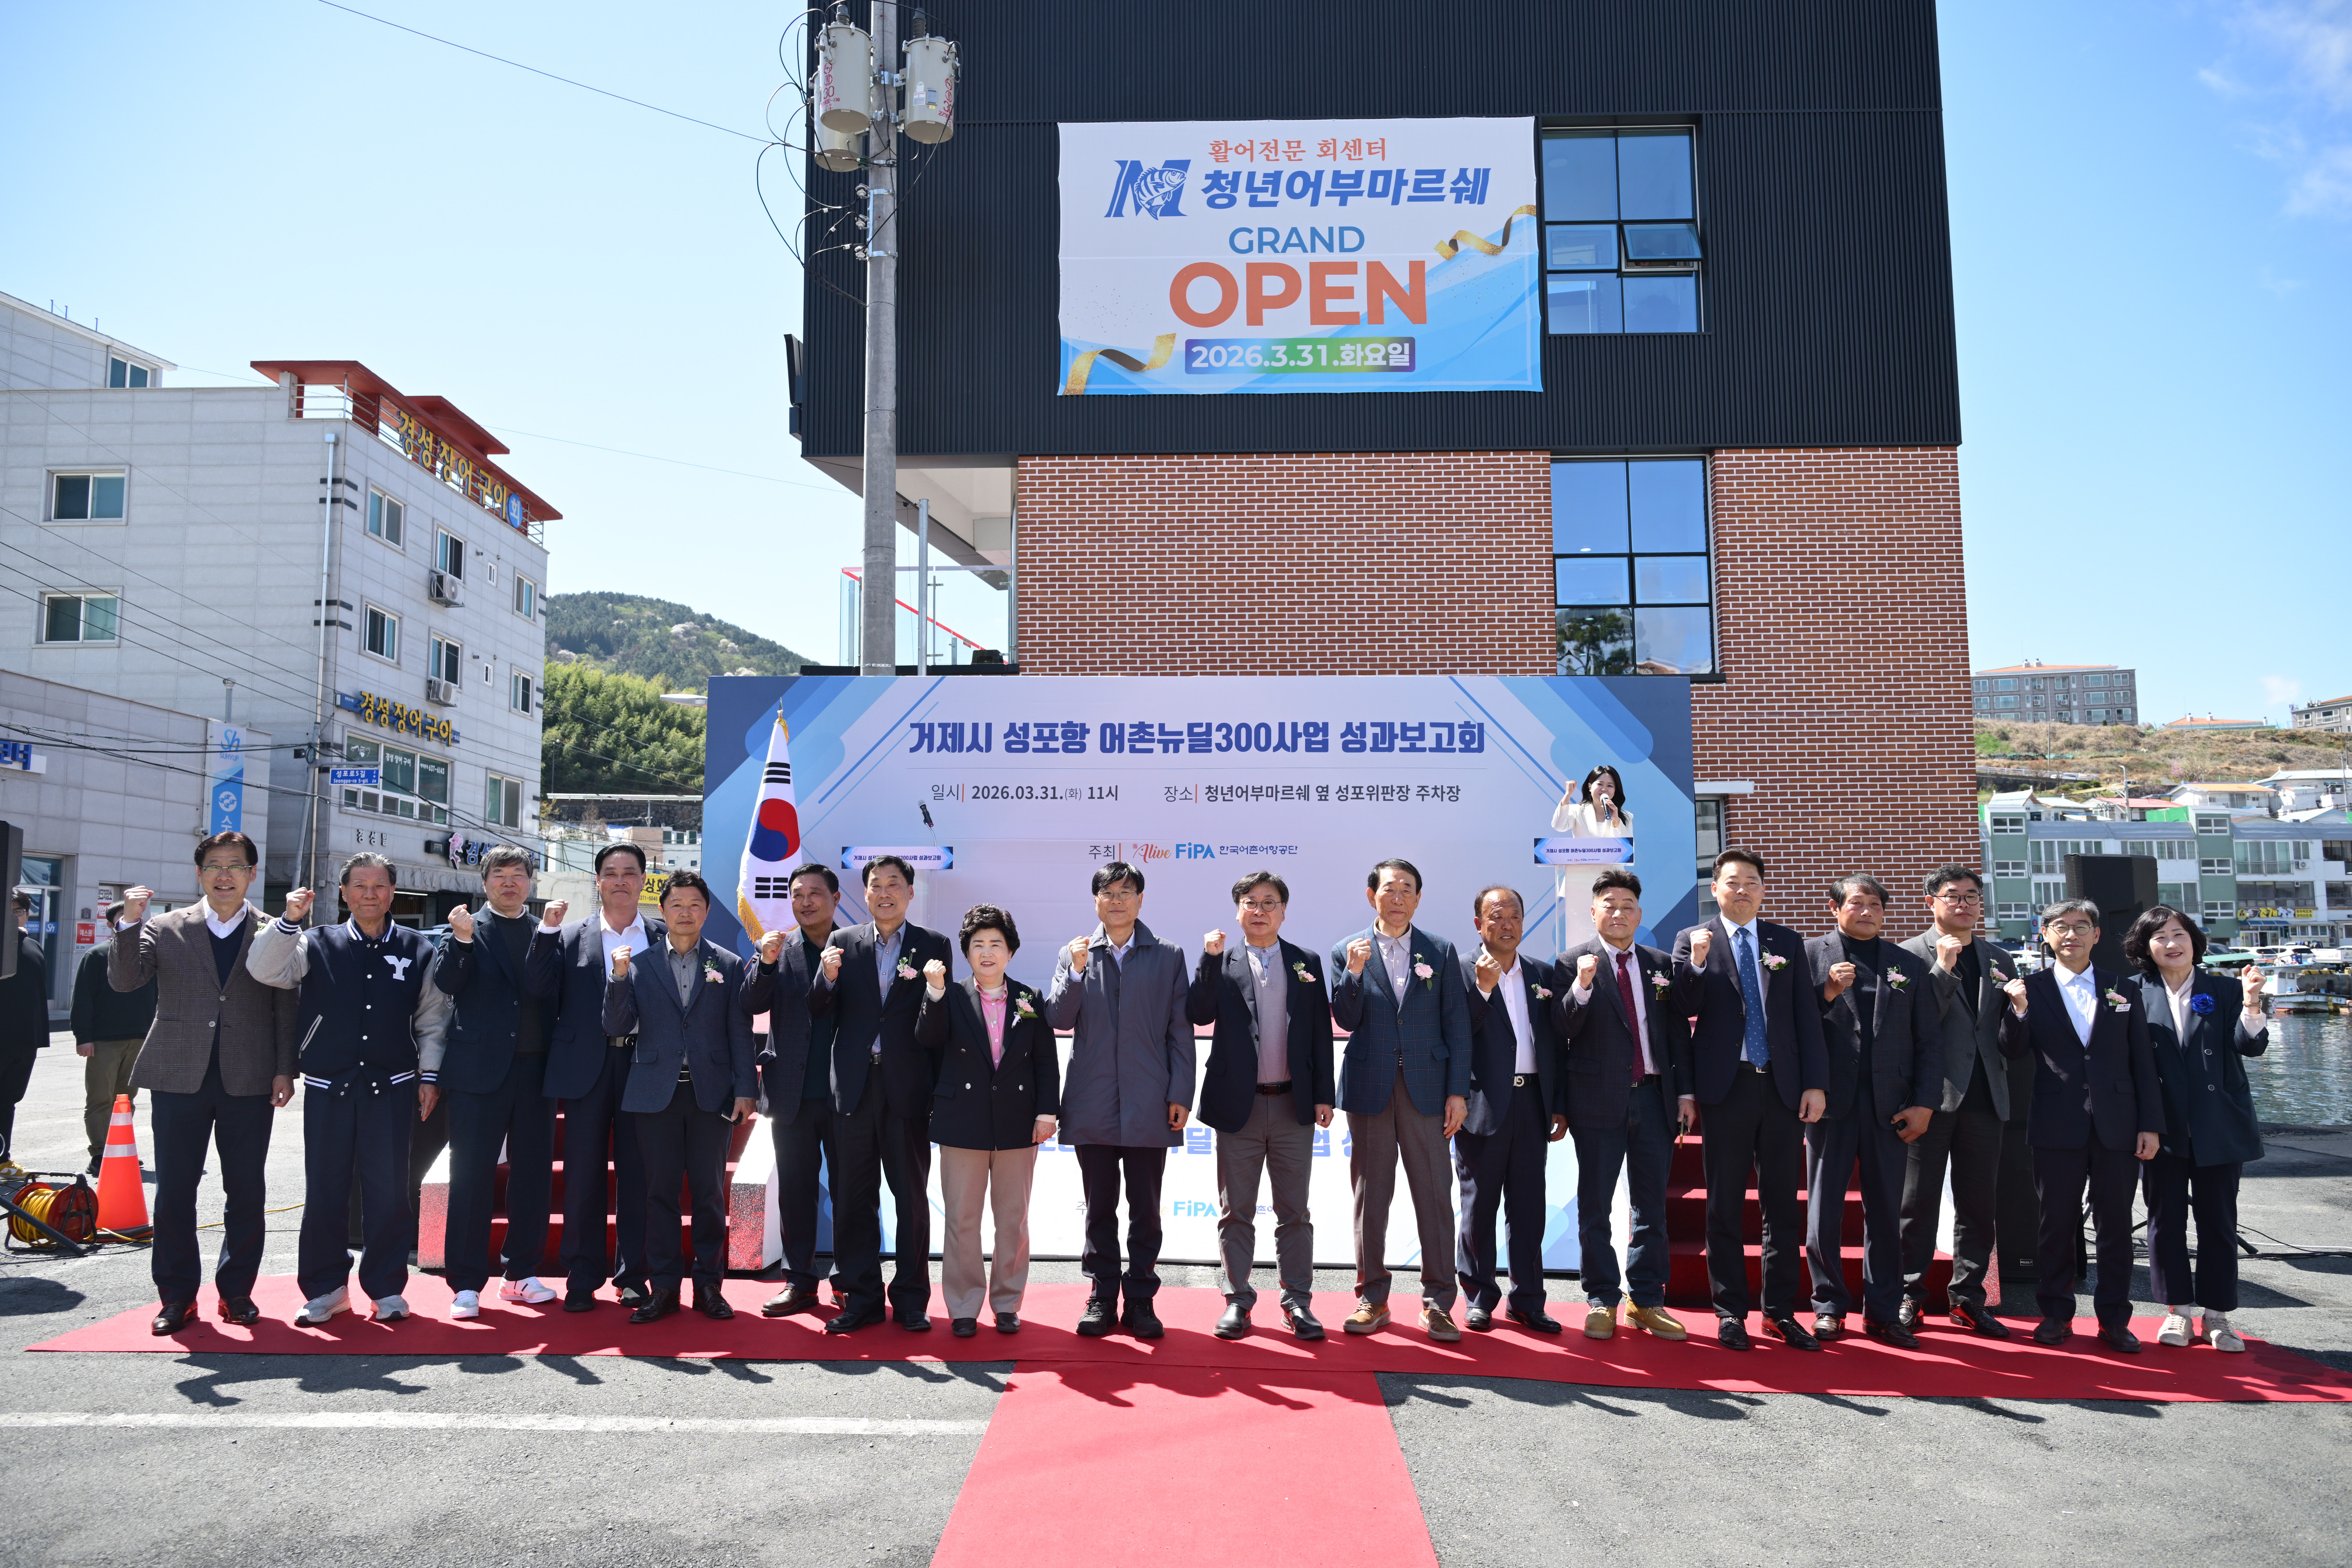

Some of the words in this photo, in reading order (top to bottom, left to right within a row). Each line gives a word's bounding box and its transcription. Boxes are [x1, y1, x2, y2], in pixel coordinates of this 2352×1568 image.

[1208, 139, 1306, 164] 활어전문
[1317, 138, 1388, 162] 회센터
[1200, 168, 1491, 210] 청년어부마르쉐
[1229, 226, 1365, 254] GRAND
[1169, 260, 1427, 328] OPEN
[1191, 342, 1410, 369] 2026.3.31.화요일
[396, 410, 507, 519] 경성장어구이
[510, 497, 520, 526] 회
[359, 690, 452, 747] 경성장어구이
[220, 729, 240, 752] Sh
[909, 722, 993, 754] 거제시
[1003, 721, 1090, 754] 성포항
[1099, 721, 1329, 754] 어촌뉴딜300사업
[1339, 721, 1485, 754] 성과보고회
[219, 752, 239, 761] SUHYUP
[386, 753, 393, 763] 경성
[395, 755, 402, 765] 장어
[403, 757, 411, 767] 구이
[336, 770, 366, 778] 성포로5길
[428, 765, 445, 775] 637-6143
[931, 783, 960, 801] 일시
[1087, 784, 1119, 801] 11시
[1164, 785, 1193, 803] 장소
[1204, 784, 1310, 803] 청년어부마르쉐
[1315, 784, 1329, 802] 옆
[1335, 784, 1411, 803] 성포위판장
[1416, 784, 1461, 803] 주차장
[1088, 845, 1116, 860] 주최
[1175, 842, 1216, 859] FiPA
[1219, 845, 1298, 856] 한국어촌어항공단
[45, 923, 55, 932] Sh
[383, 955, 412, 981] Y
[1173, 1200, 1218, 1217] FiPA
